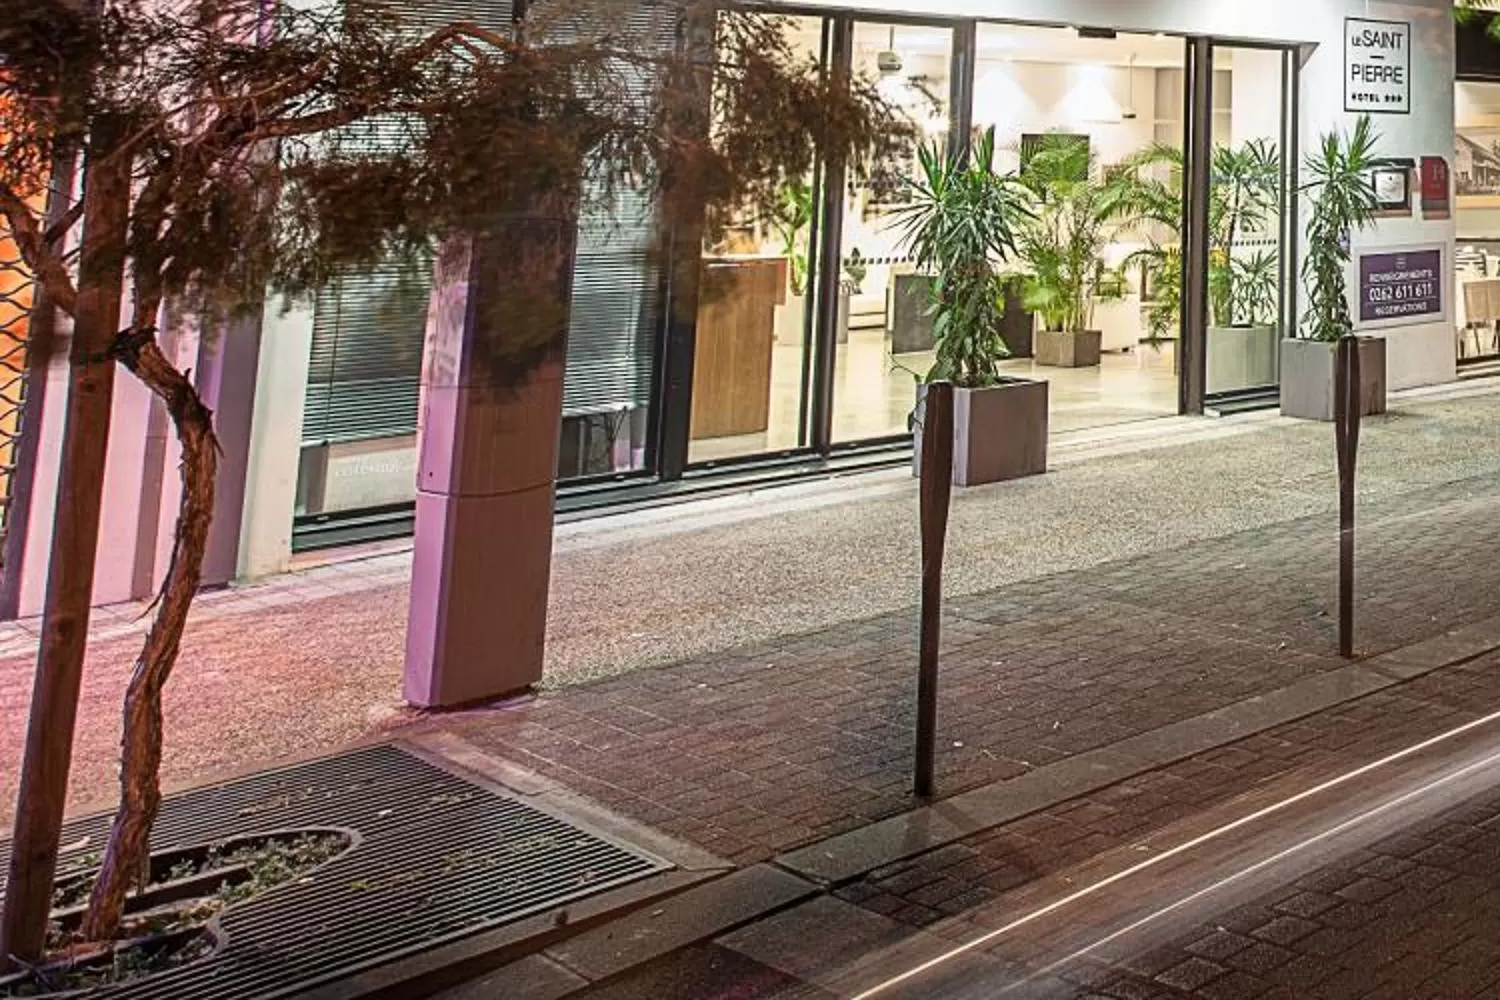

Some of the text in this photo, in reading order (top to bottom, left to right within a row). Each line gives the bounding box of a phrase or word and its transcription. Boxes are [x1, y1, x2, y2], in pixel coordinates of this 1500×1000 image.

[1362, 29, 1403, 50] SAINT
[1351, 63, 1403, 84] PIERRE
[1395, 285, 1413, 299] 611
[1415, 283, 1432, 297] 611
